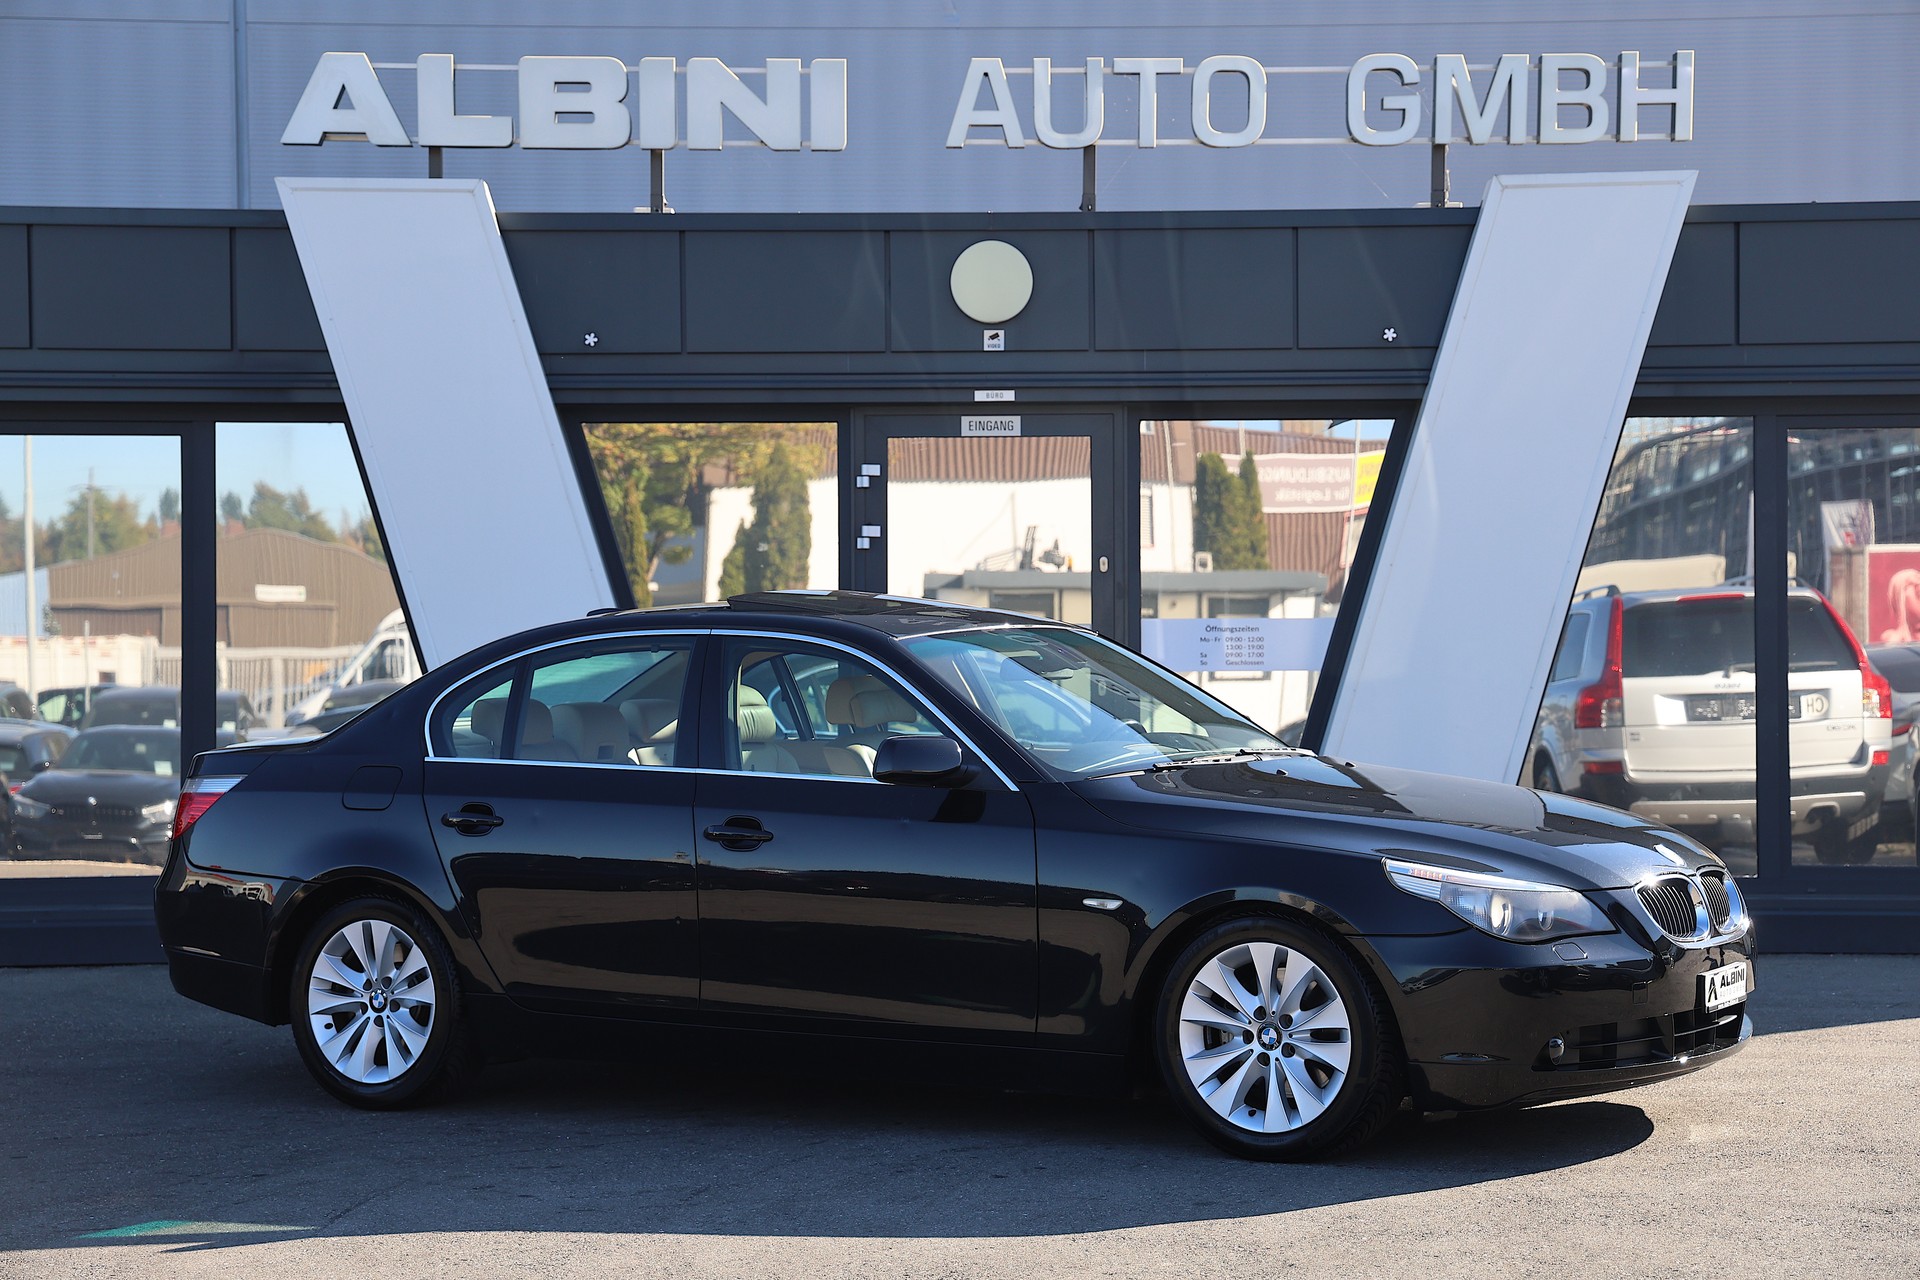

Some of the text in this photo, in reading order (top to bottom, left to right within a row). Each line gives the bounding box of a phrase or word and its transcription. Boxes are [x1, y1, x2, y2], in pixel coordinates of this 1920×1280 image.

[280, 49, 1696, 151] ALBINI AUTO GMBH
[968, 420, 1014, 431] EINGANG
[1206, 625, 1260, 633] Öffnungszeiten
[1720, 968, 1744, 988] ALBINI
